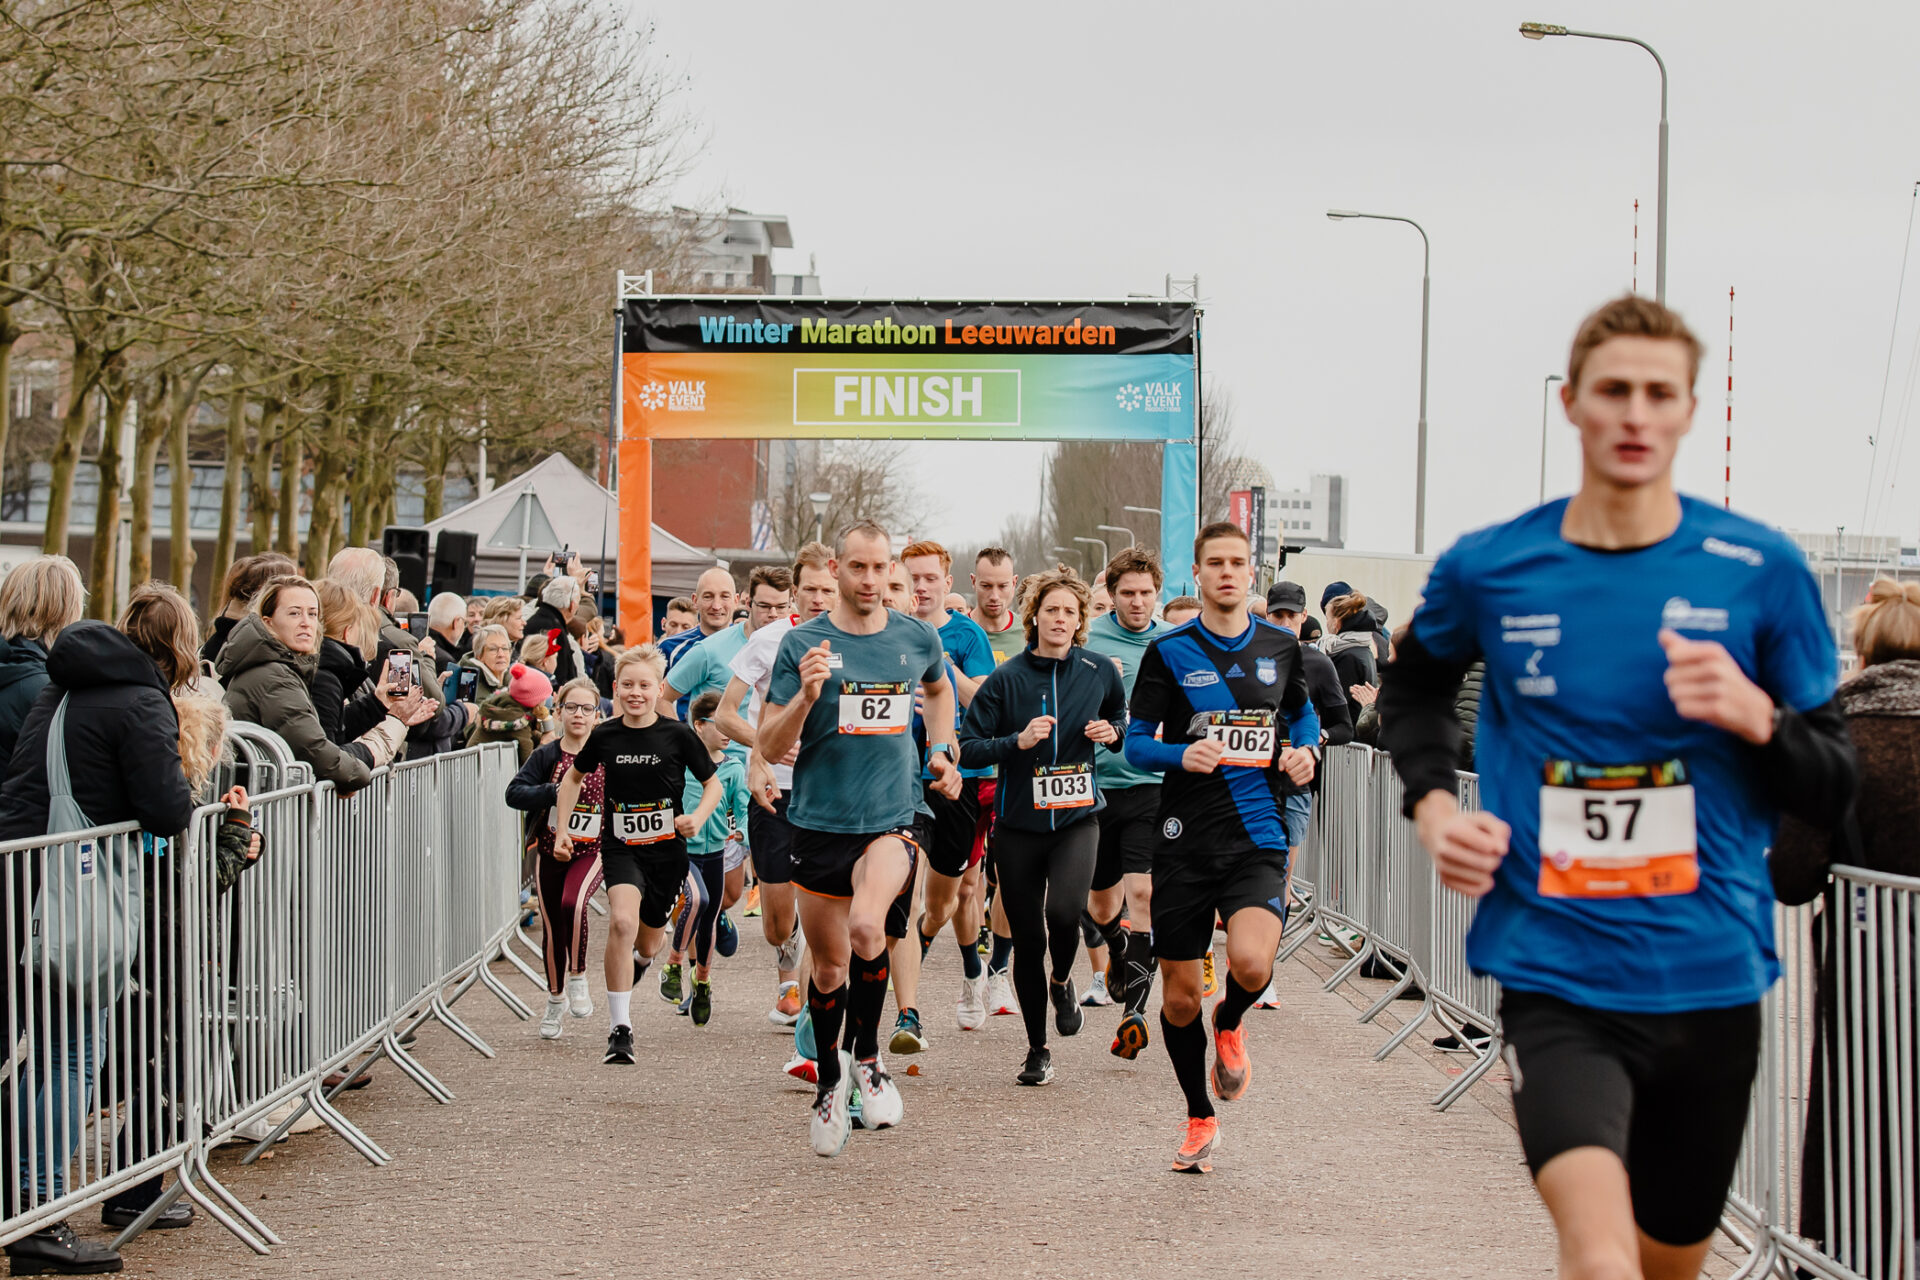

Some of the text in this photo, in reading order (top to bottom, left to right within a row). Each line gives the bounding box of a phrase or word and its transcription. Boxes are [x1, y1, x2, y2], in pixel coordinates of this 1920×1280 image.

[699, 316, 1116, 345] Winter Marathon Leeuwarden
[668, 381, 706, 394] VALK
[834, 375, 983, 416] FINISH
[1145, 382, 1181, 396] VALK
[668, 394, 706, 406] EVENT
[1145, 396, 1181, 407] EVENT
[861, 698, 891, 720] 62
[1213, 727, 1270, 751] 1062
[616, 755, 651, 764] CRAFT
[1038, 775, 1087, 798] 1033
[568, 813, 592, 831] 07
[623, 813, 663, 834] 506
[1584, 799, 1643, 841] 57
